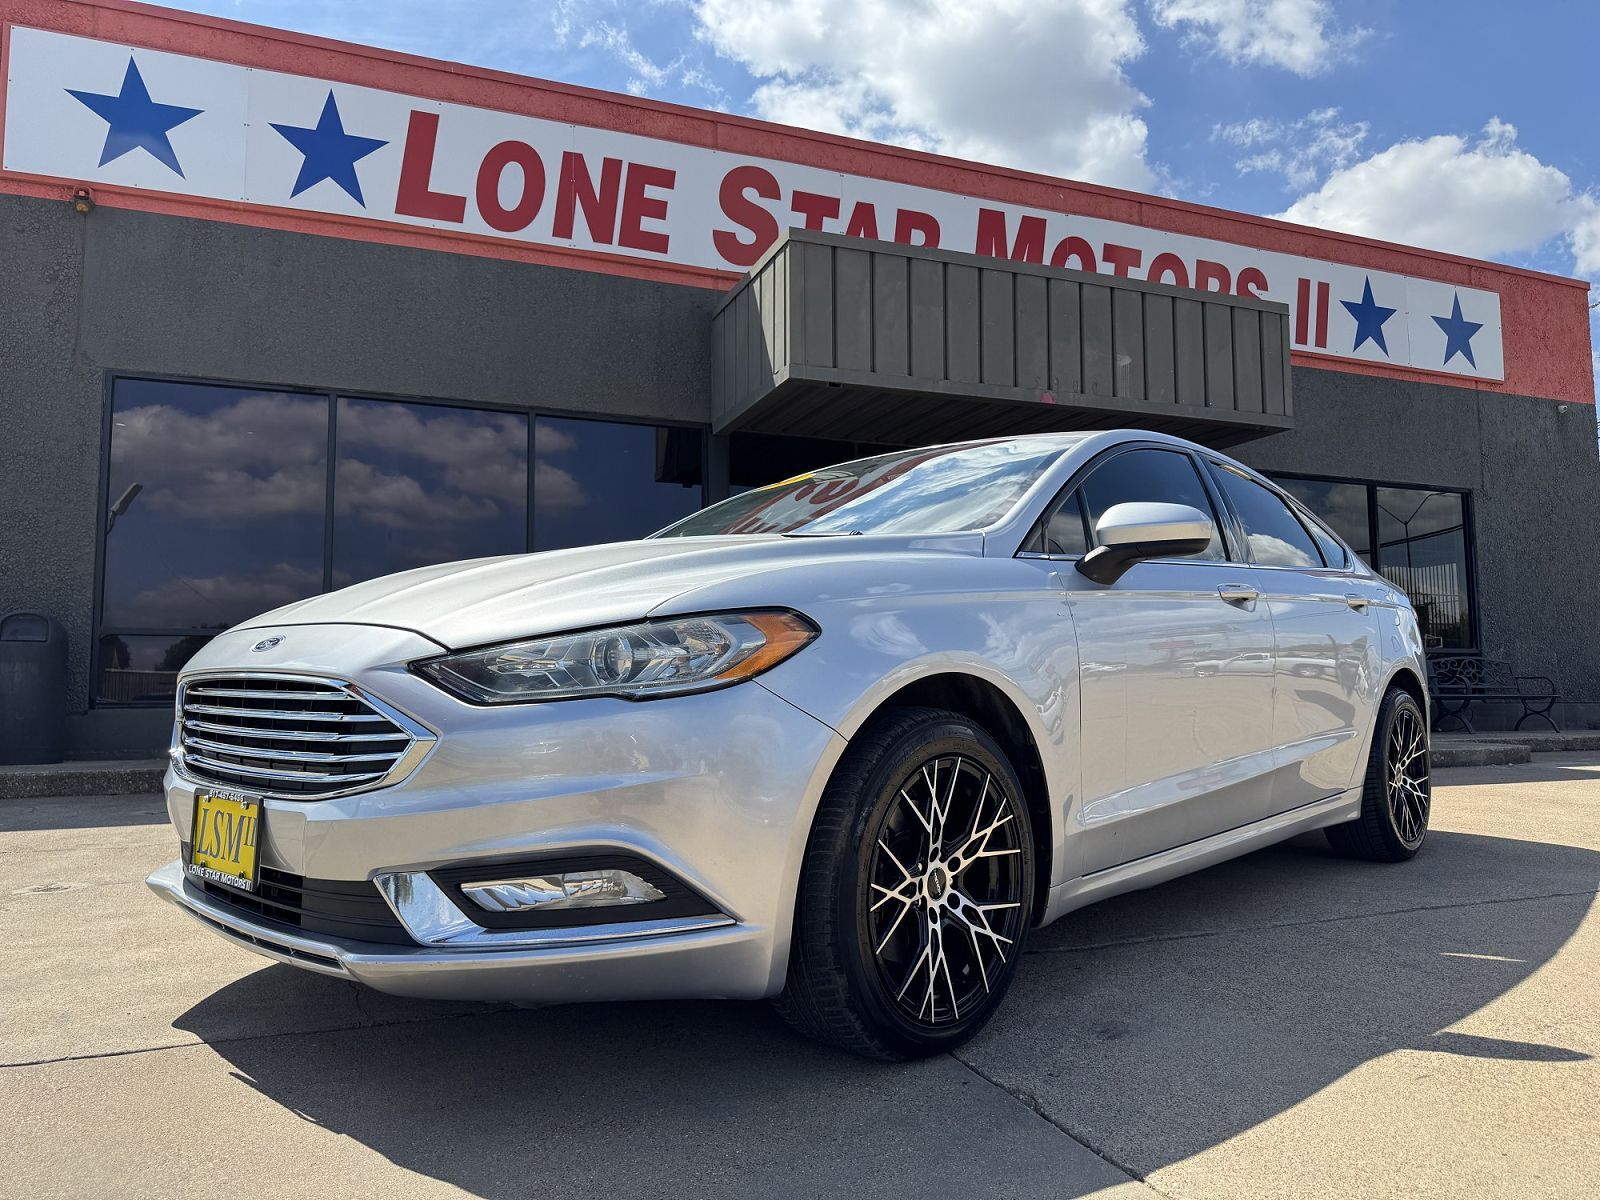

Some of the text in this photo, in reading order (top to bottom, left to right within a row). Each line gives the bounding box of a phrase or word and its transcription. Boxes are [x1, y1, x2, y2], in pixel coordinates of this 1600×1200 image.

[394, 109, 676, 254] LONE
[1295, 277, 1330, 348] II
[188, 865, 205, 876] LONE
[205, 869, 221, 881] STAR
[221, 874, 245, 888] MOTORS
